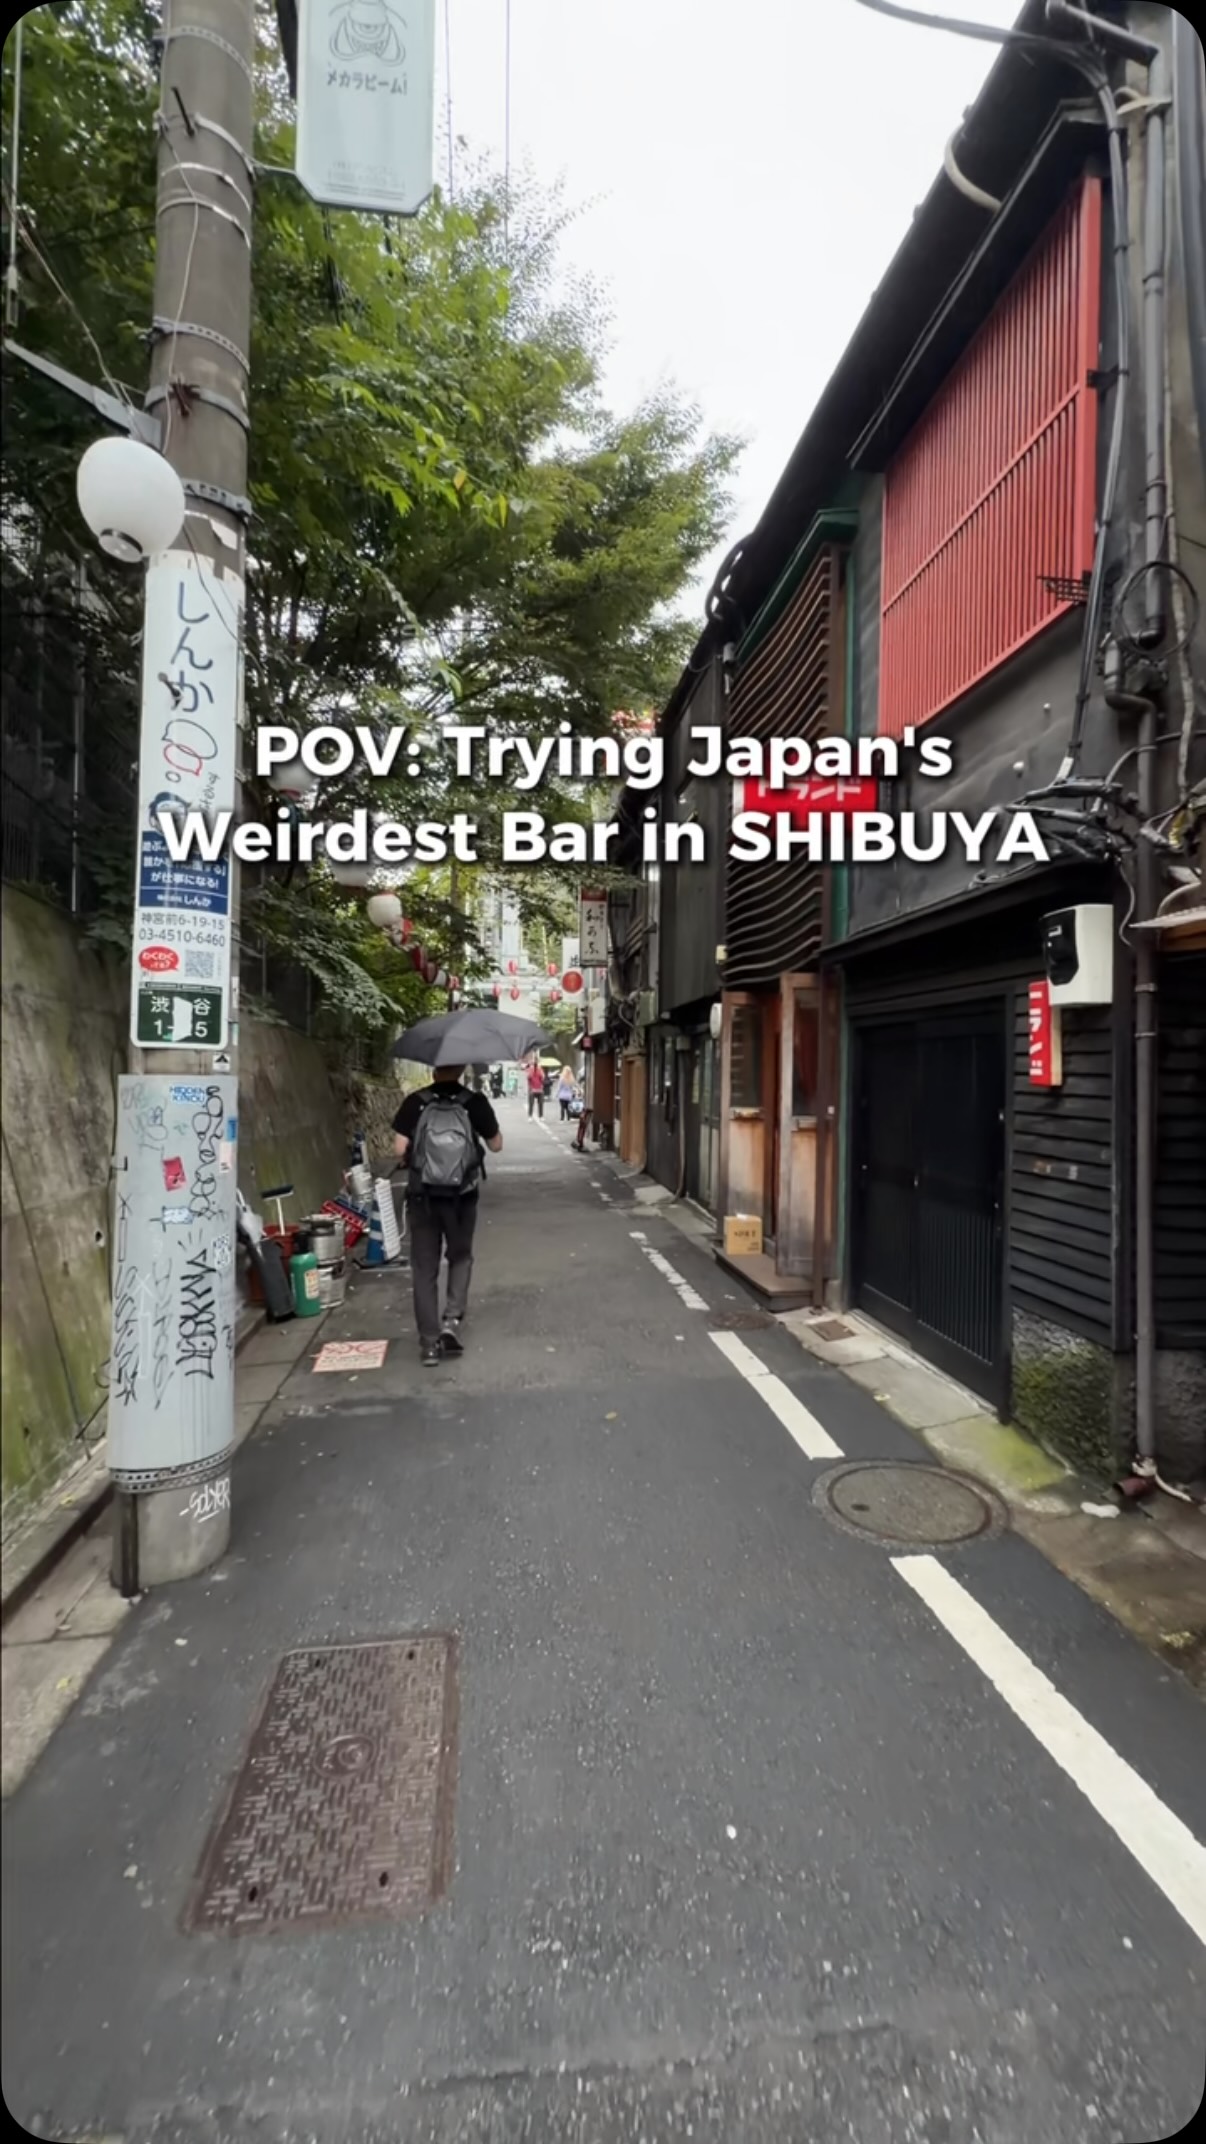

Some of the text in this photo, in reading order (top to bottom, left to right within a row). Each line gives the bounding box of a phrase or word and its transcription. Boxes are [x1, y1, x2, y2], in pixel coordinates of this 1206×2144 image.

[141, 912, 225, 931] 神宮前6-19-15
[139, 929, 226, 947] 03-4510-6460
